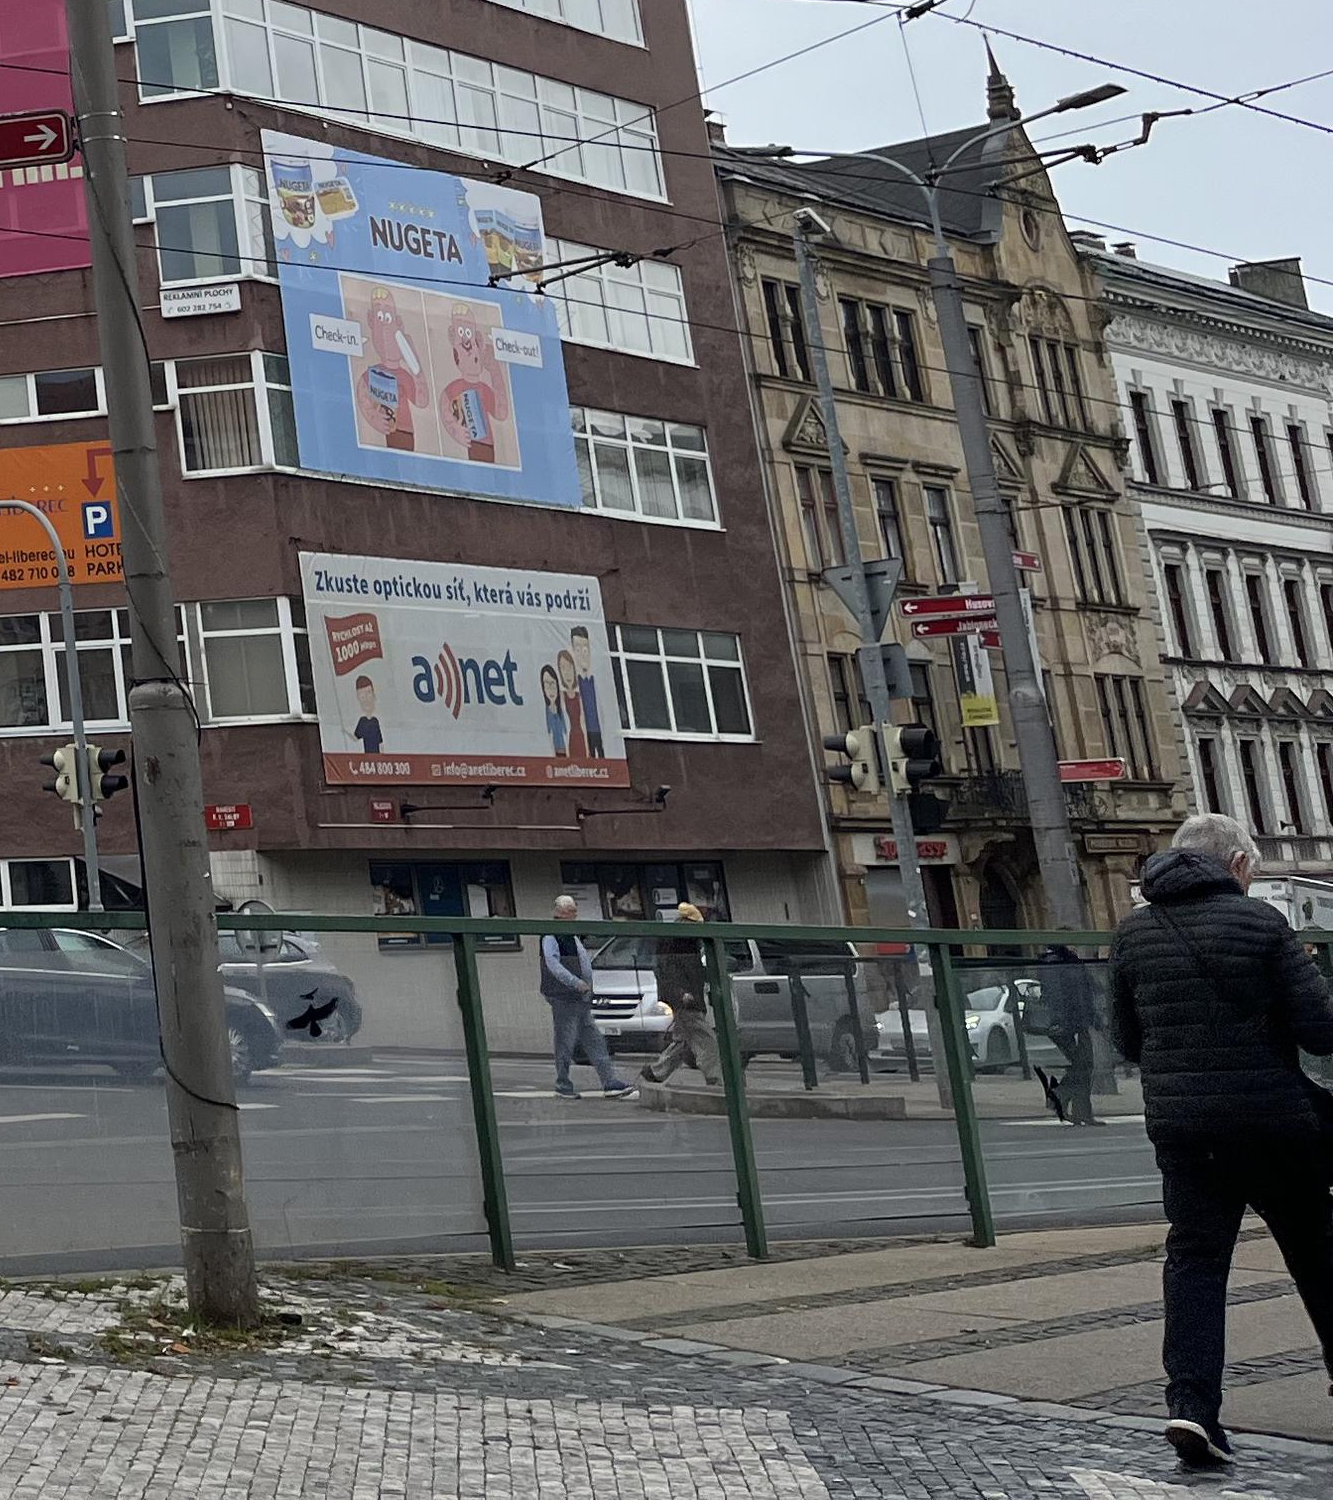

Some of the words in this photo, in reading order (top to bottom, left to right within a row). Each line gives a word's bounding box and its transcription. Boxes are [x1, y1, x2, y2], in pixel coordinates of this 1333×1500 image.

[368, 214, 464, 266] NUGETA
[369, 386, 398, 404] NUGETA
[462, 393, 478, 439] NUGETA
[85, 506, 107, 535] P
[1, 569, 24, 581] 482
[28, 567, 48, 580] 710
[51, 566, 75, 578] 08
[314, 570, 368, 595] Zkuste
[373, 574, 442, 601] optickou
[446, 576, 472, 607] síť,
[473, 581, 514, 607] která
[516, 583, 542, 608] vás
[546, 587, 591, 612] podrží
[335, 640, 359, 662] 1000
[359, 762, 376, 775] 484
[377, 762, 393, 775] 800
[394, 762, 410, 776] 300
